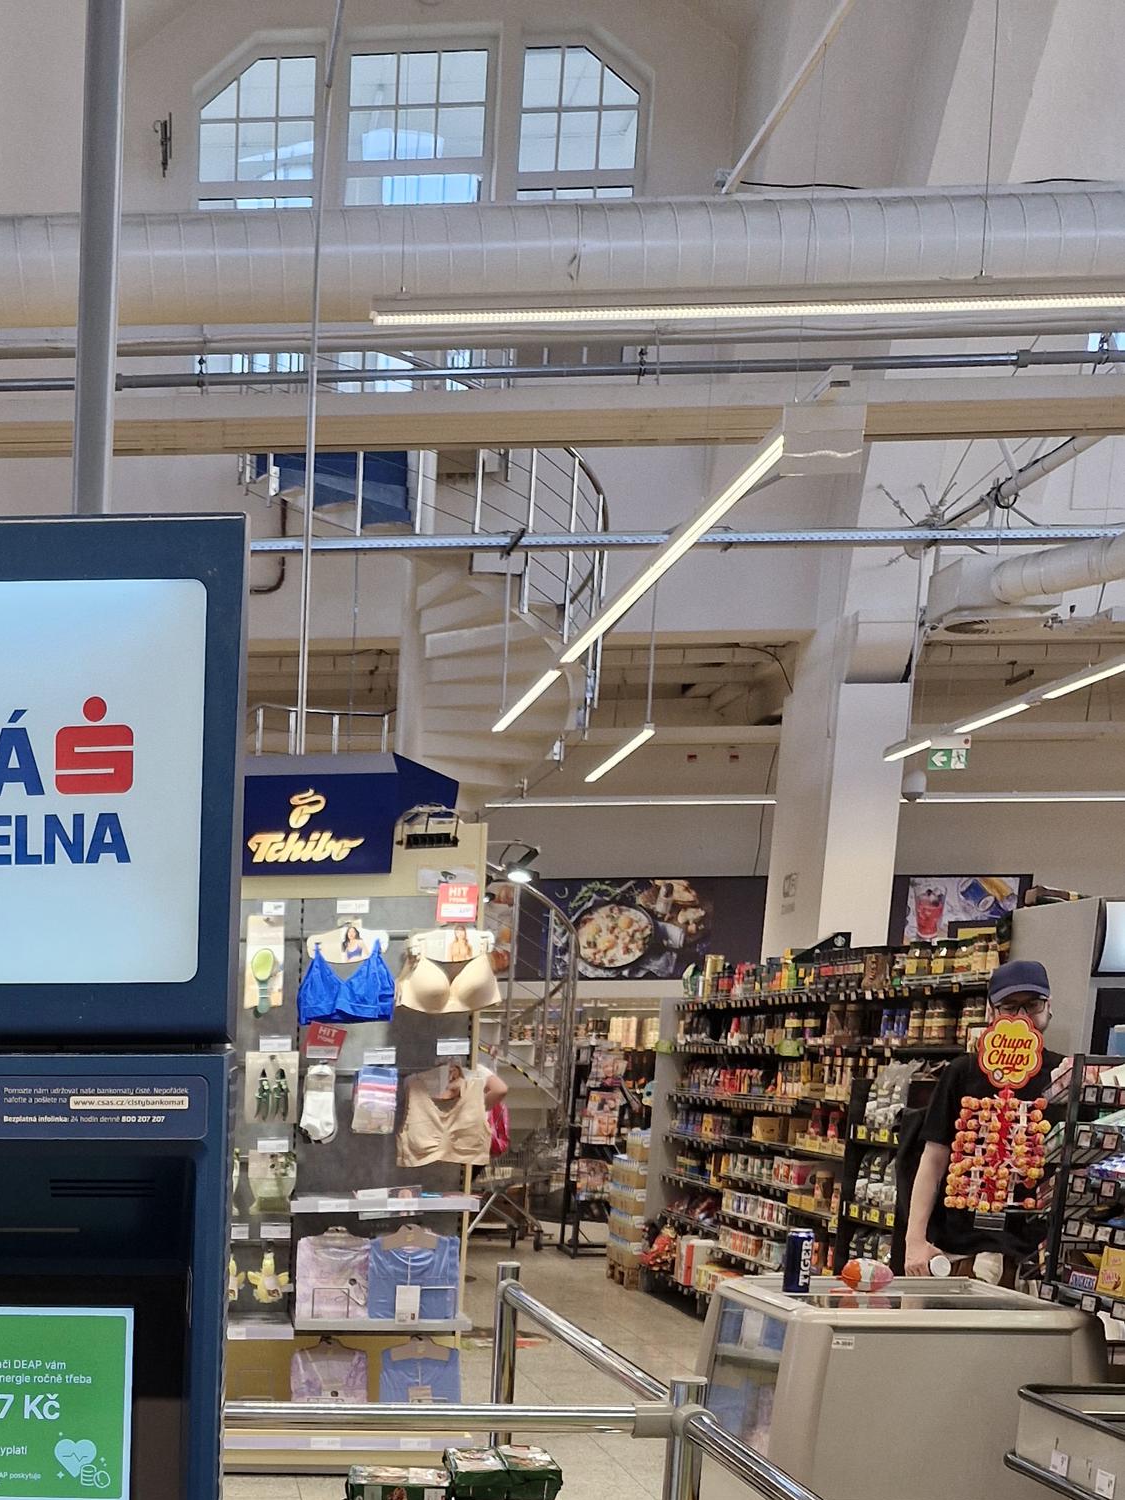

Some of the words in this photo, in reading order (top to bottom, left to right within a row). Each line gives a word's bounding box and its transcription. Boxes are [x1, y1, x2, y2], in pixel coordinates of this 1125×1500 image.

[248, 831, 365, 863] Tchibo
[448, 886, 470, 897] HIT
[317, 1026, 338, 1038] HIT
[990, 1034, 1033, 1053] Chupa
[987, 1049, 1031, 1069] Chups
[33, 1087, 49, 1095] nám
[96, 1087, 134, 1096] bankomaty
[3, 1115, 37, 1124] Bezplatná
[80, 1115, 99, 1123] hodin
[122, 1115, 136, 1123] 800
[137, 1115, 151, 1123] 207
[152, 1115, 165, 1123] 207
[799, 1239, 813, 1287] TIGER
[14, 1360, 42, 1369] DEAP
[45, 1360, 66, 1369] vám
[33, 1374, 62, 1383] ročně
[65, 1375, 92, 1384] třeba
[24, 1393, 60, 1420] Kč
